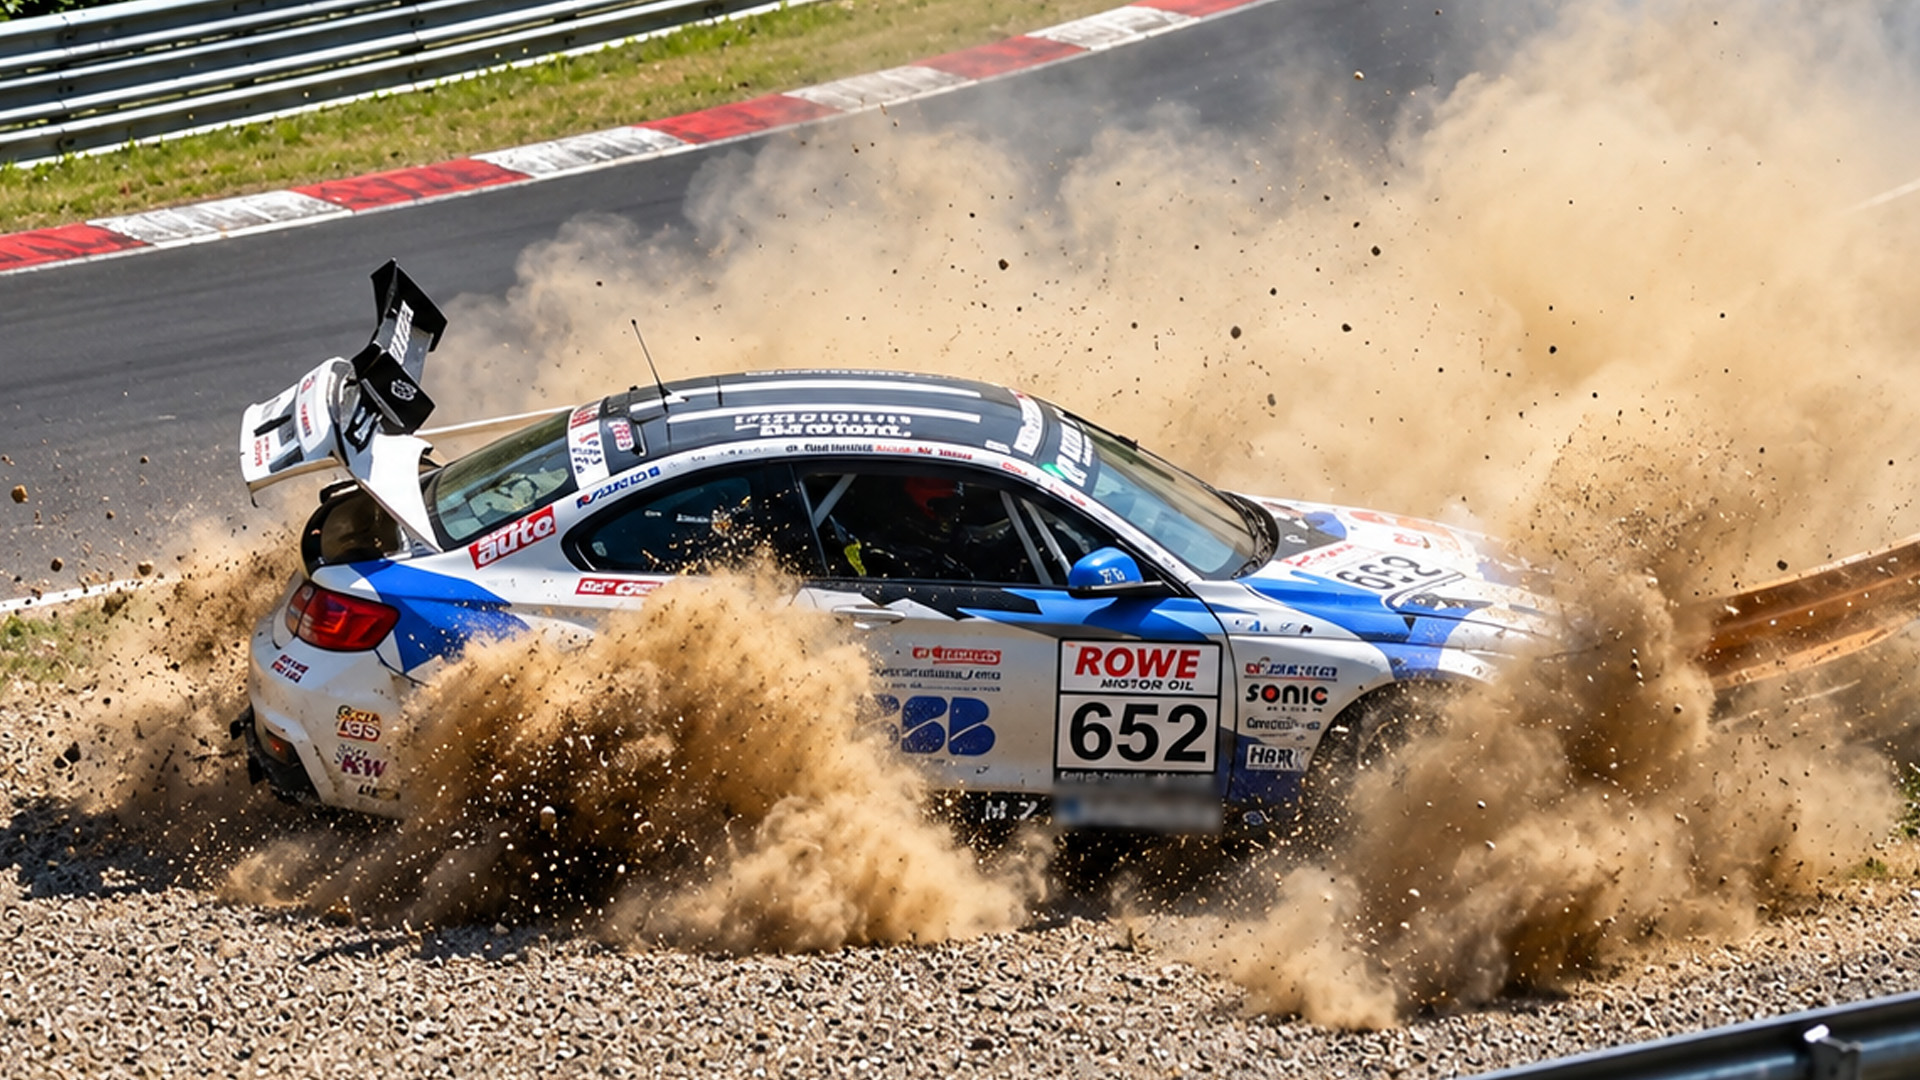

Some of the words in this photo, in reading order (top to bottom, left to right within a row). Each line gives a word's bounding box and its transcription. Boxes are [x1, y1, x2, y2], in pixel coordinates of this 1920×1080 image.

[477, 515, 555, 566] auto
[1074, 646, 1201, 679] ROWE
[1100, 679, 1163, 691] MOTOR
[1168, 680, 1194, 692] OIL
[1070, 702, 1208, 763] 652
